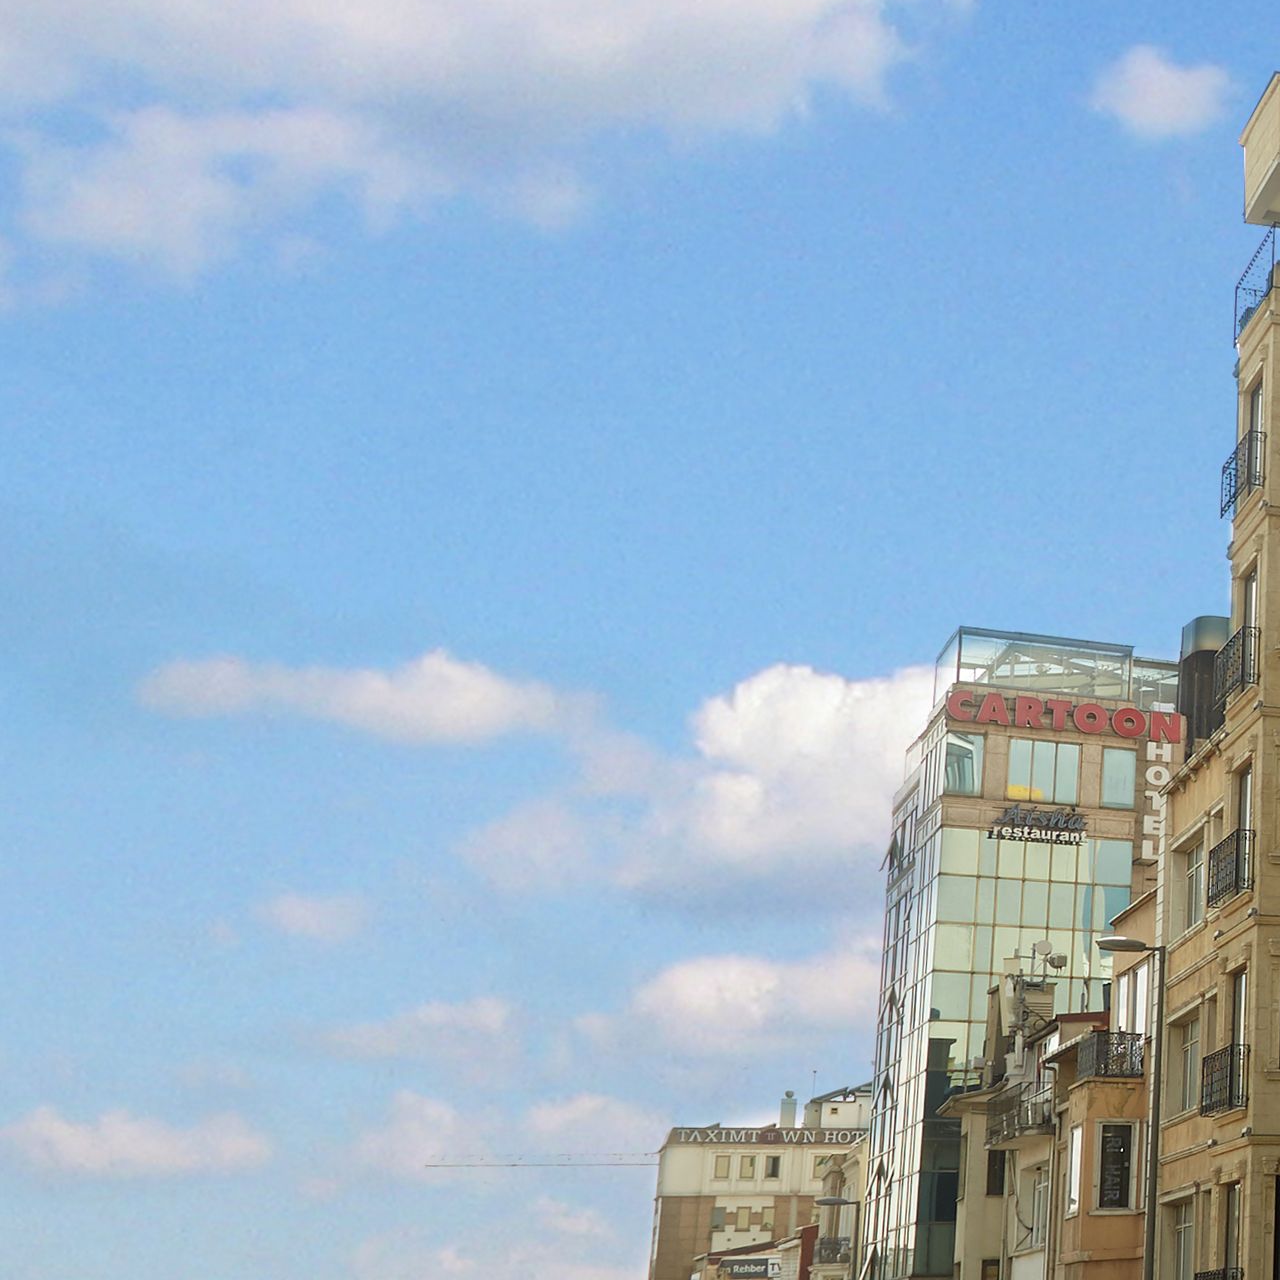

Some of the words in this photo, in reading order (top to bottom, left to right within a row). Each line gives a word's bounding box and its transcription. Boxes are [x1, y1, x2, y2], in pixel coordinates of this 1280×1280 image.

[946, 690, 1182, 743] CARTOON
[1142, 741, 1172, 859] HOTEL
[991, 825, 1089, 842] restaurant
[823, 1130, 864, 1144] HOT
[733, 1265, 766, 1274] Rehber
